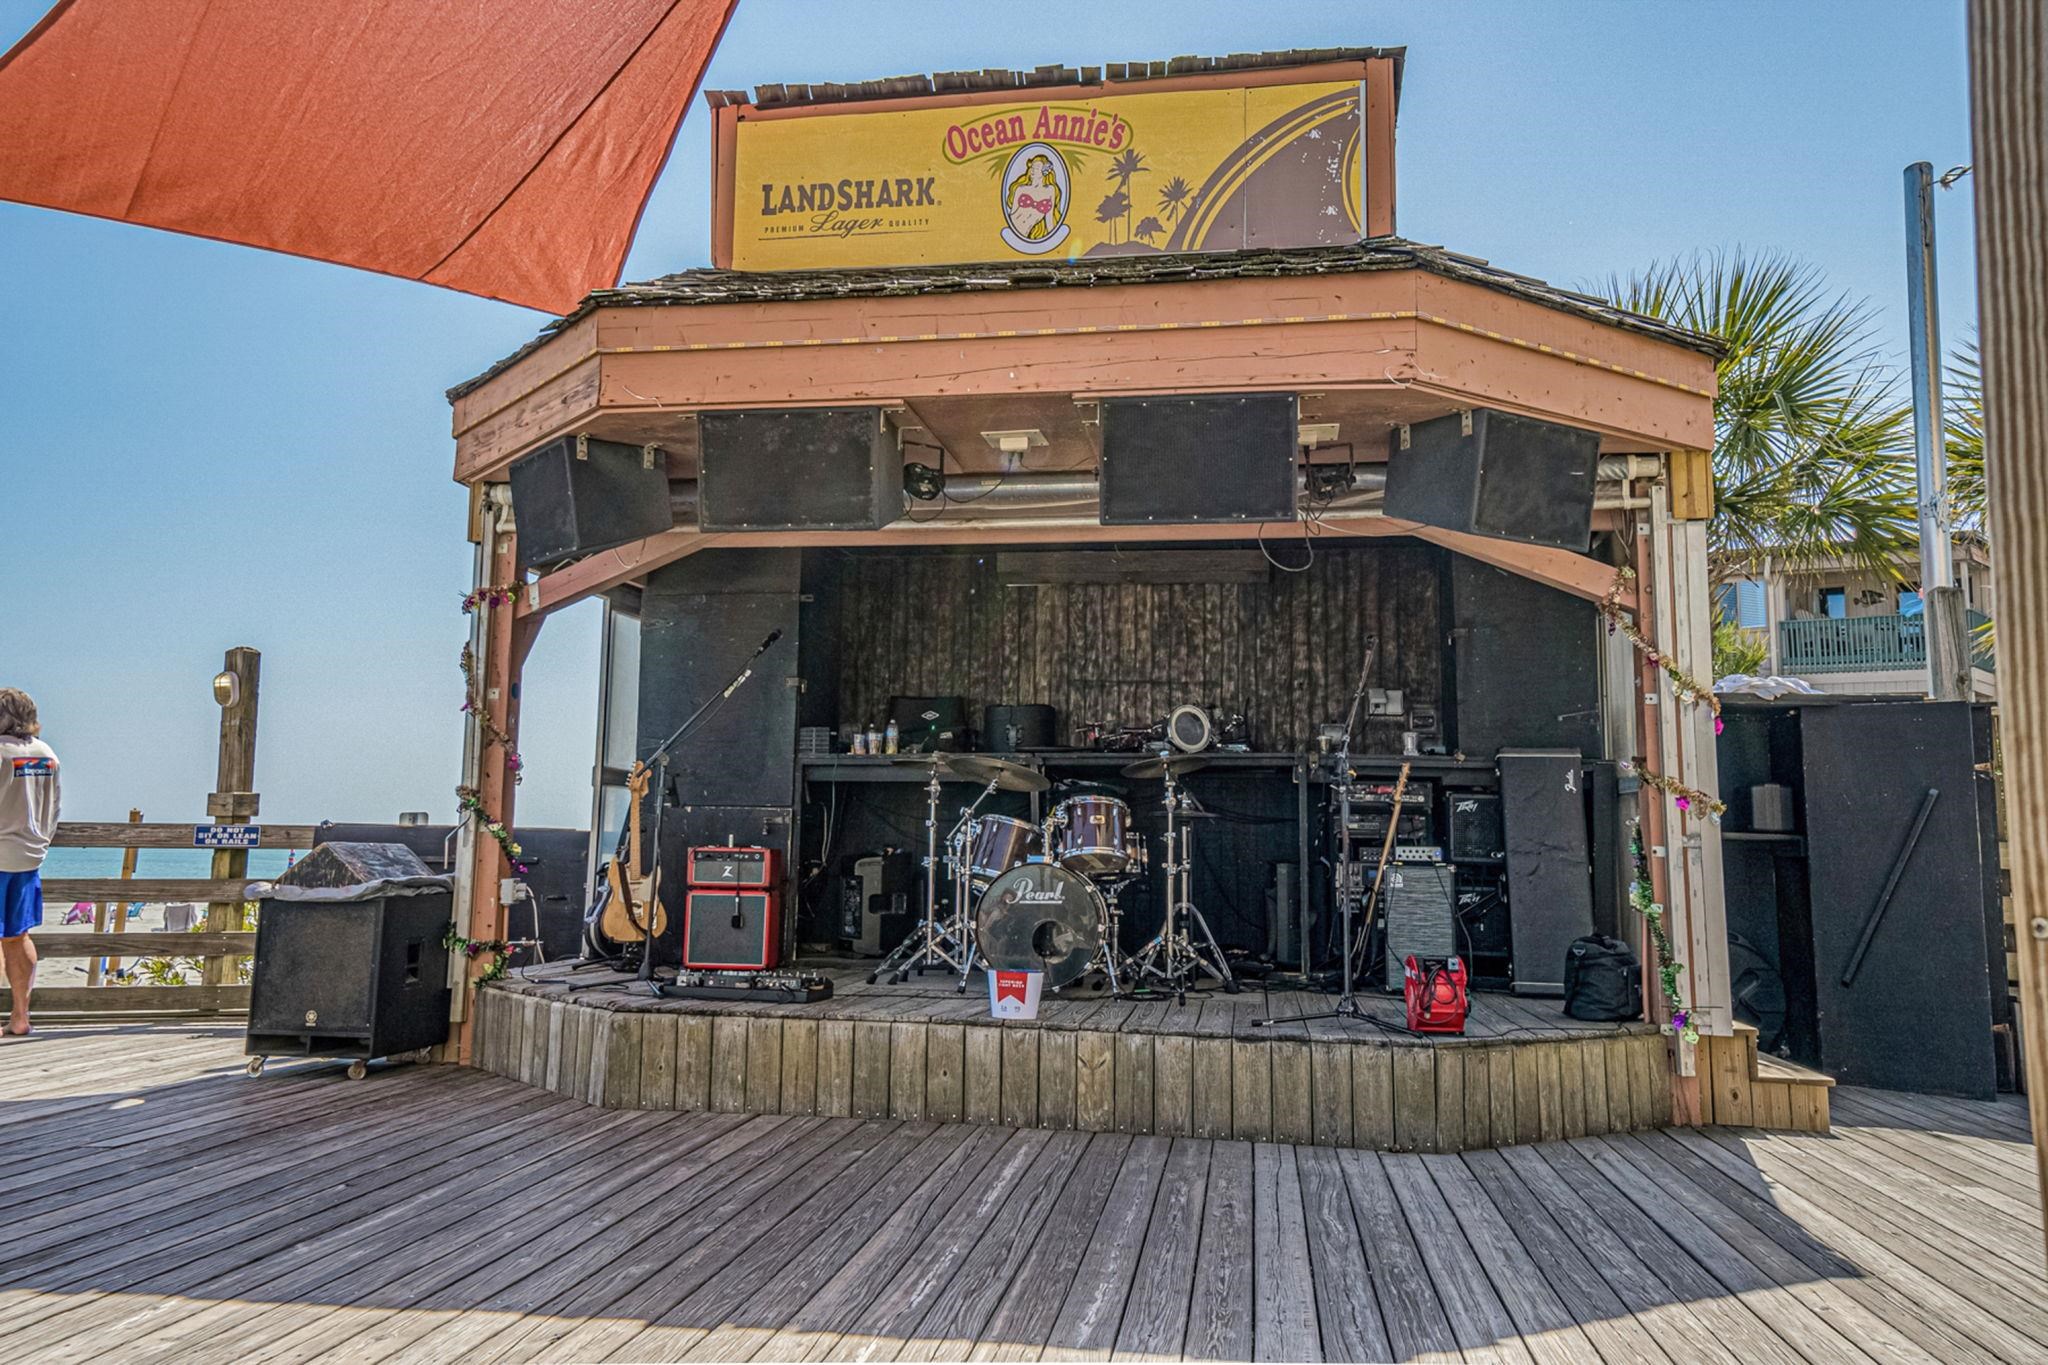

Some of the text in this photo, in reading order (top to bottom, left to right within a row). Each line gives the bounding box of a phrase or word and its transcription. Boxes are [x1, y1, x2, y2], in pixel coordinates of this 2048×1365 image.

[947, 105, 1126, 159] Ocean Annie's
[761, 176, 936, 216] LANDSHARK
[764, 210, 930, 239] PREMIUM Lager QUALITY
[1005, 877, 1065, 904] Pearl
